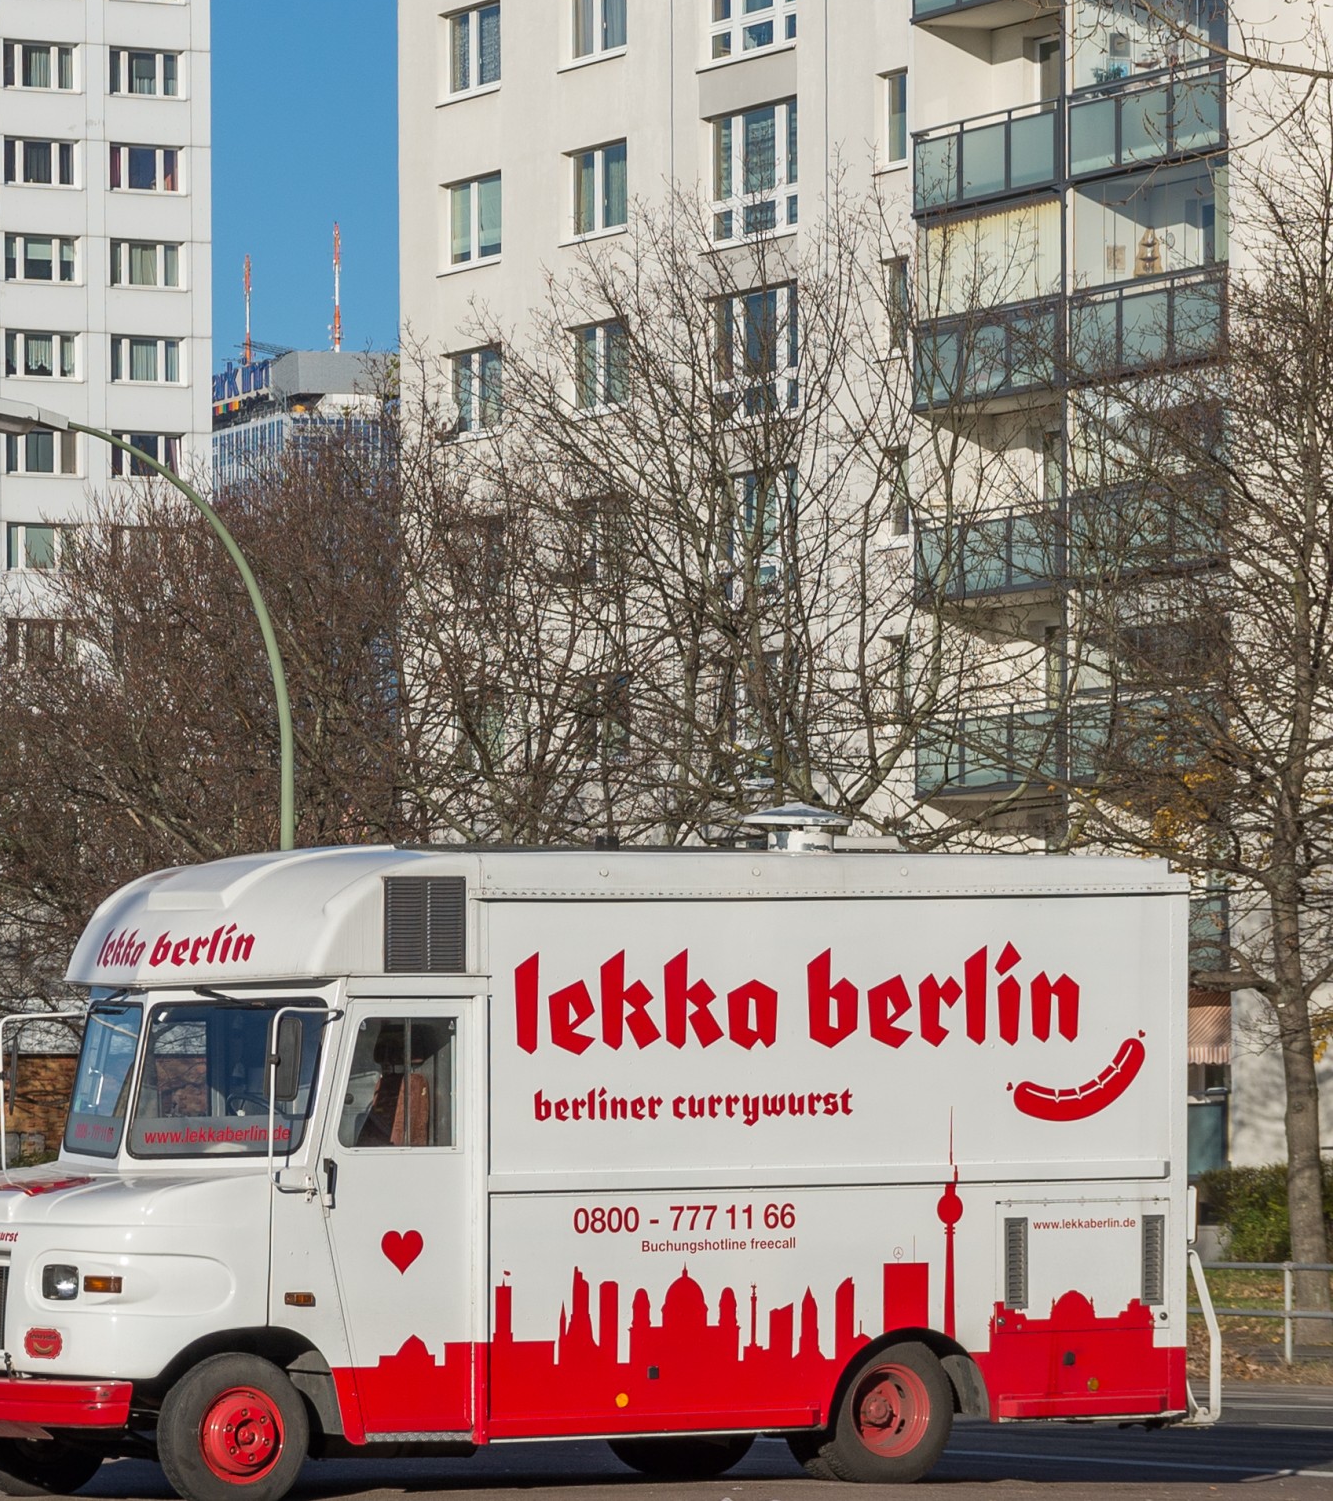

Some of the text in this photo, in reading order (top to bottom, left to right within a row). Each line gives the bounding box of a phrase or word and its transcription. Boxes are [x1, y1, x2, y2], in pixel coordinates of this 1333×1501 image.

[97, 922, 255, 968] lekka berlin
[514, 941, 1080, 1056] lekka berlin
[534, 1086, 854, 1127] berliner currywurst
[573, 1206, 641, 1234] 0800
[669, 1204, 718, 1232] 777
[725, 1203, 753, 1230] 11
[763, 1202, 796, 1230] 66
[1033, 1218, 1136, 1230] www.lekkaberlin.de
[641, 1236, 796, 1254] Buchungshotline freecall
